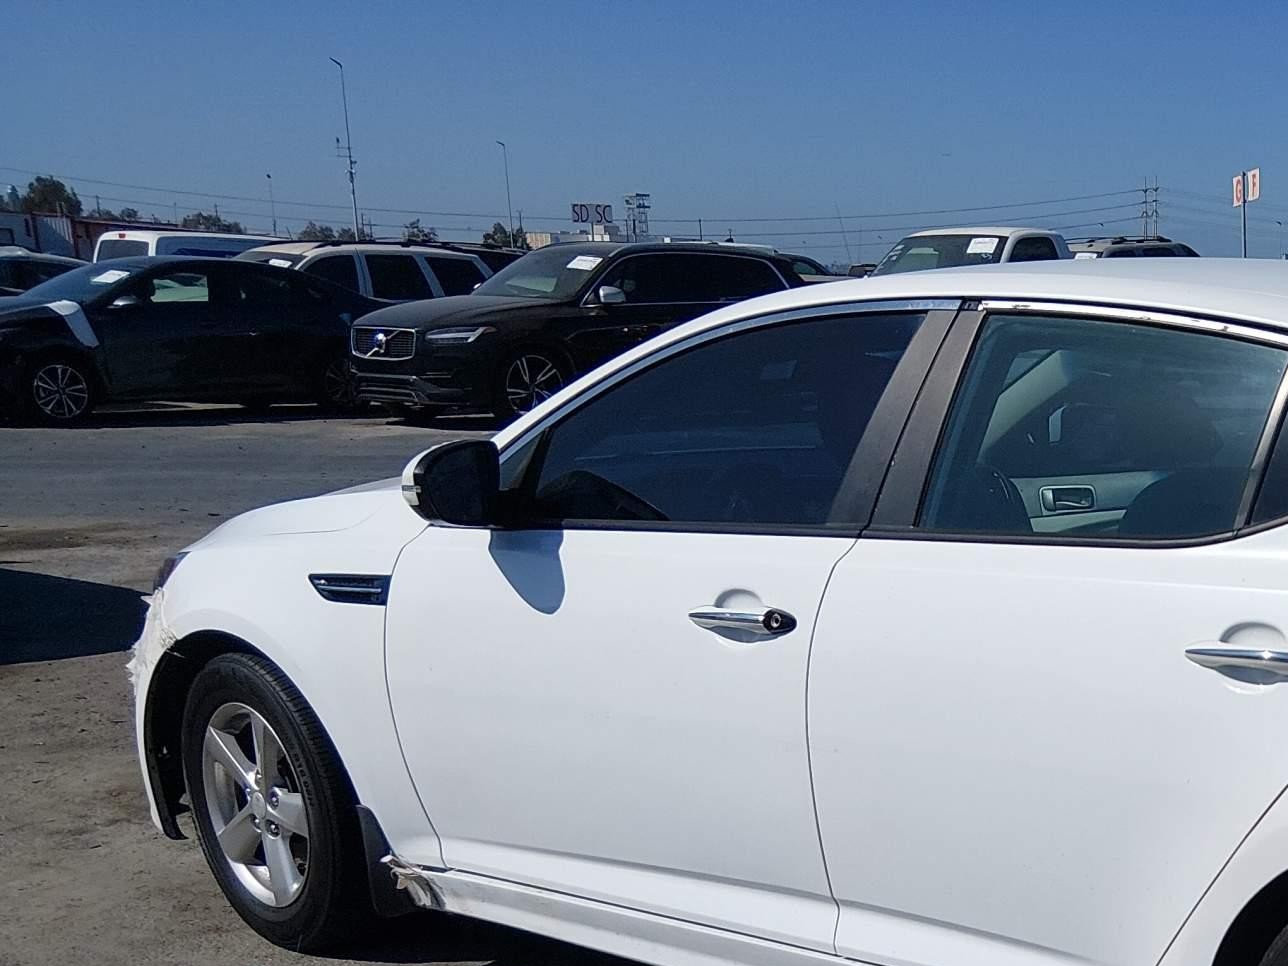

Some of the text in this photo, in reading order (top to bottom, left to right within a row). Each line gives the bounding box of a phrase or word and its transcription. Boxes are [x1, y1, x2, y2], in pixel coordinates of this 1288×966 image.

[1235, 178, 1242, 203] G
[1251, 173, 1257, 198] F
[572, 203, 612, 223] SD SC
